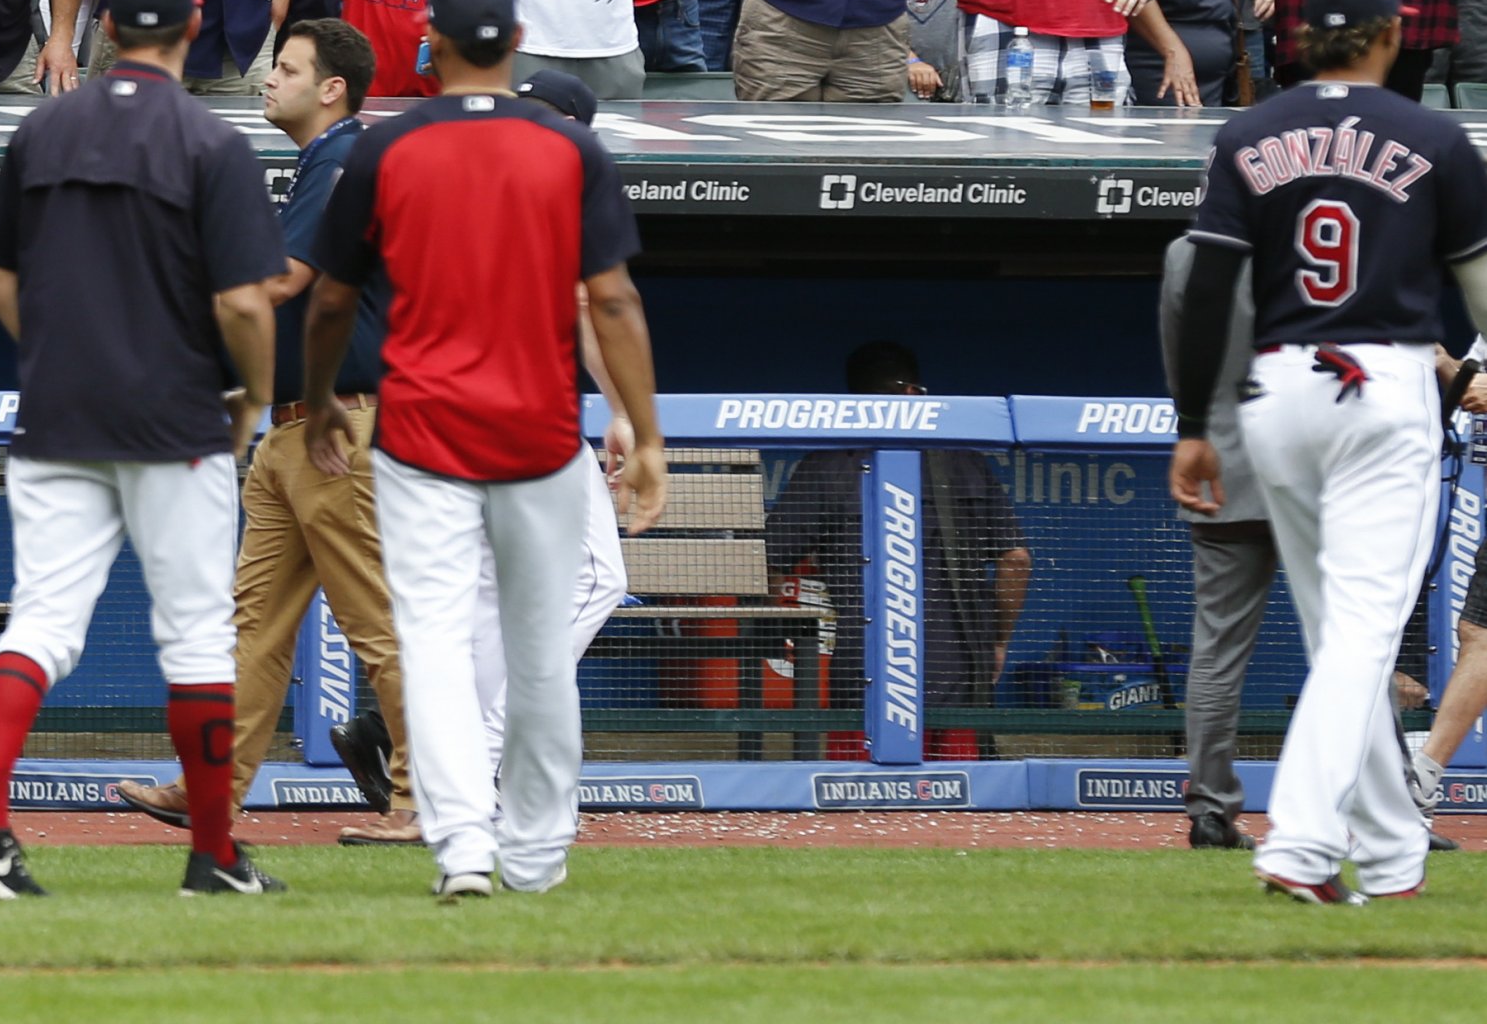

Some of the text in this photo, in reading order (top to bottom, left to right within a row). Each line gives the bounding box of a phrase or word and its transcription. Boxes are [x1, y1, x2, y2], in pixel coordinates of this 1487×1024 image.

[1233, 115, 1434, 204] GONZÁLEZ
[690, 180, 751, 202] Clinic
[859, 182, 1028, 206] Cleveland Clinic
[1136, 186, 1202, 208] Clevel
[1293, 197, 1361, 308] 9
[715, 398, 943, 431] PROGRESSIVE
[883, 481, 918, 734] PROGRESSIVE
[1109, 683, 1161, 711] GIANT
[10, 780, 120, 803] INDIANS.C
[579, 781, 695, 803] DIANS.COM
[821, 779, 963, 802] INDIANS.COM
